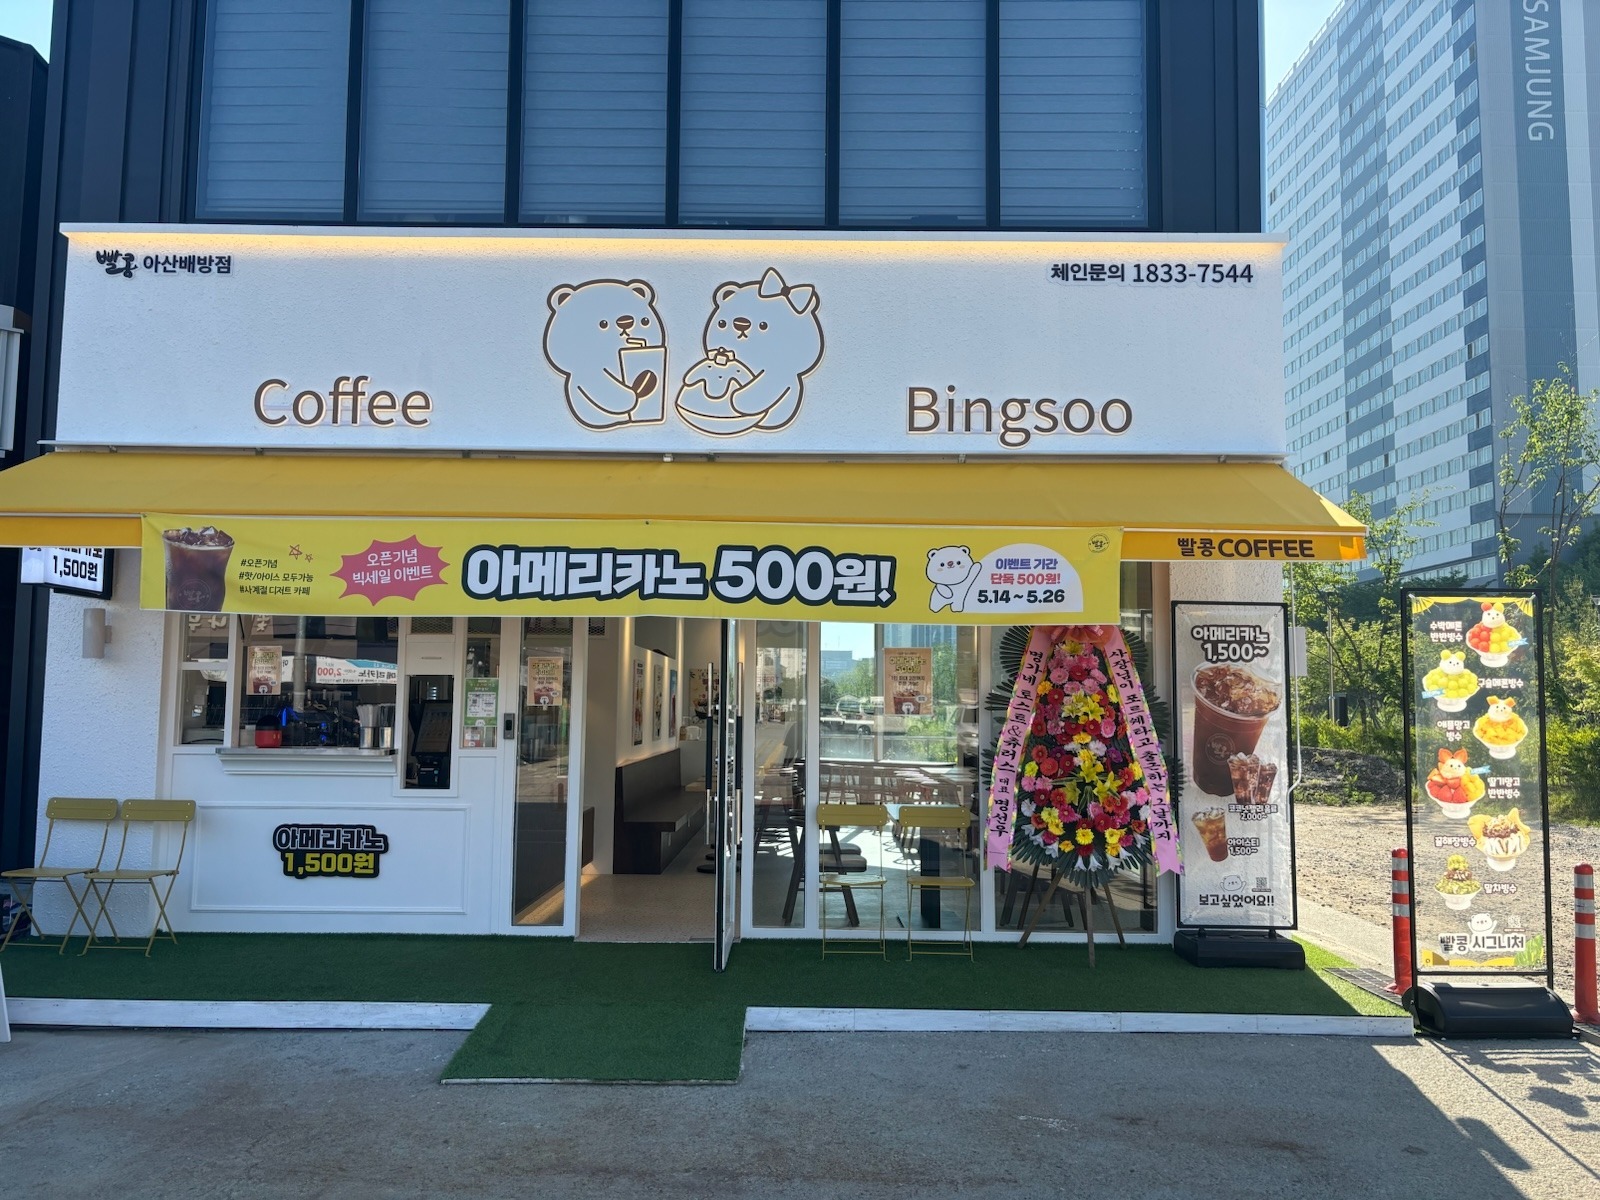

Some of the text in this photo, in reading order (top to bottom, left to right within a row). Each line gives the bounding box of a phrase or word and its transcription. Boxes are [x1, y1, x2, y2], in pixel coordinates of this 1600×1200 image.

[1523, 0, 1554, 141] SAMJUNG
[143, 255, 232, 274] 아산배방점
[1051, 263, 1253, 283] 체인문의 1833-7544
[254, 375, 431, 426] Coffee
[908, 385, 1133, 447] Bingsoo
[240, 558, 278, 569] #오픈기념
[366, 548, 418, 567] 오픈기념
[995, 558, 1058, 570] 이벤트 기간
[53, 555, 98, 582] 1,500원
[352, 565, 434, 586] 빅세일 이벤트
[465, 547, 894, 603] 아메리카노 500원!
[282, 573, 314, 583] 모두가능
[990, 573, 1061, 585] 단독 500원!
[239, 585, 311, 596] #사계절 디저트 카페
[1192, 625, 1269, 642] 아메리카노
[1430, 632, 1463, 643] 반반빙수
[1203, 643, 1268, 661] 1,500~
[1436, 720, 1470, 731] 애플망고
[1109, 648, 1135, 690] 사장님이
[1152, 798, 1173, 841] 그날까지
[1446, 731, 1462, 742] 빙수
[1487, 777, 1521, 788] 딸기망고
[1487, 788, 1521, 799] 반반빙수
[275, 827, 386, 851] 아메리카노
[1228, 838, 1260, 847] 아이스티
[285, 852, 375, 875] 1,500원
[1484, 883, 1517, 894] 말차빙수
[1199, 894, 1275, 908] 보고싶었어요!!
[1440, 935, 1524, 952] 빨콩 시그니처
